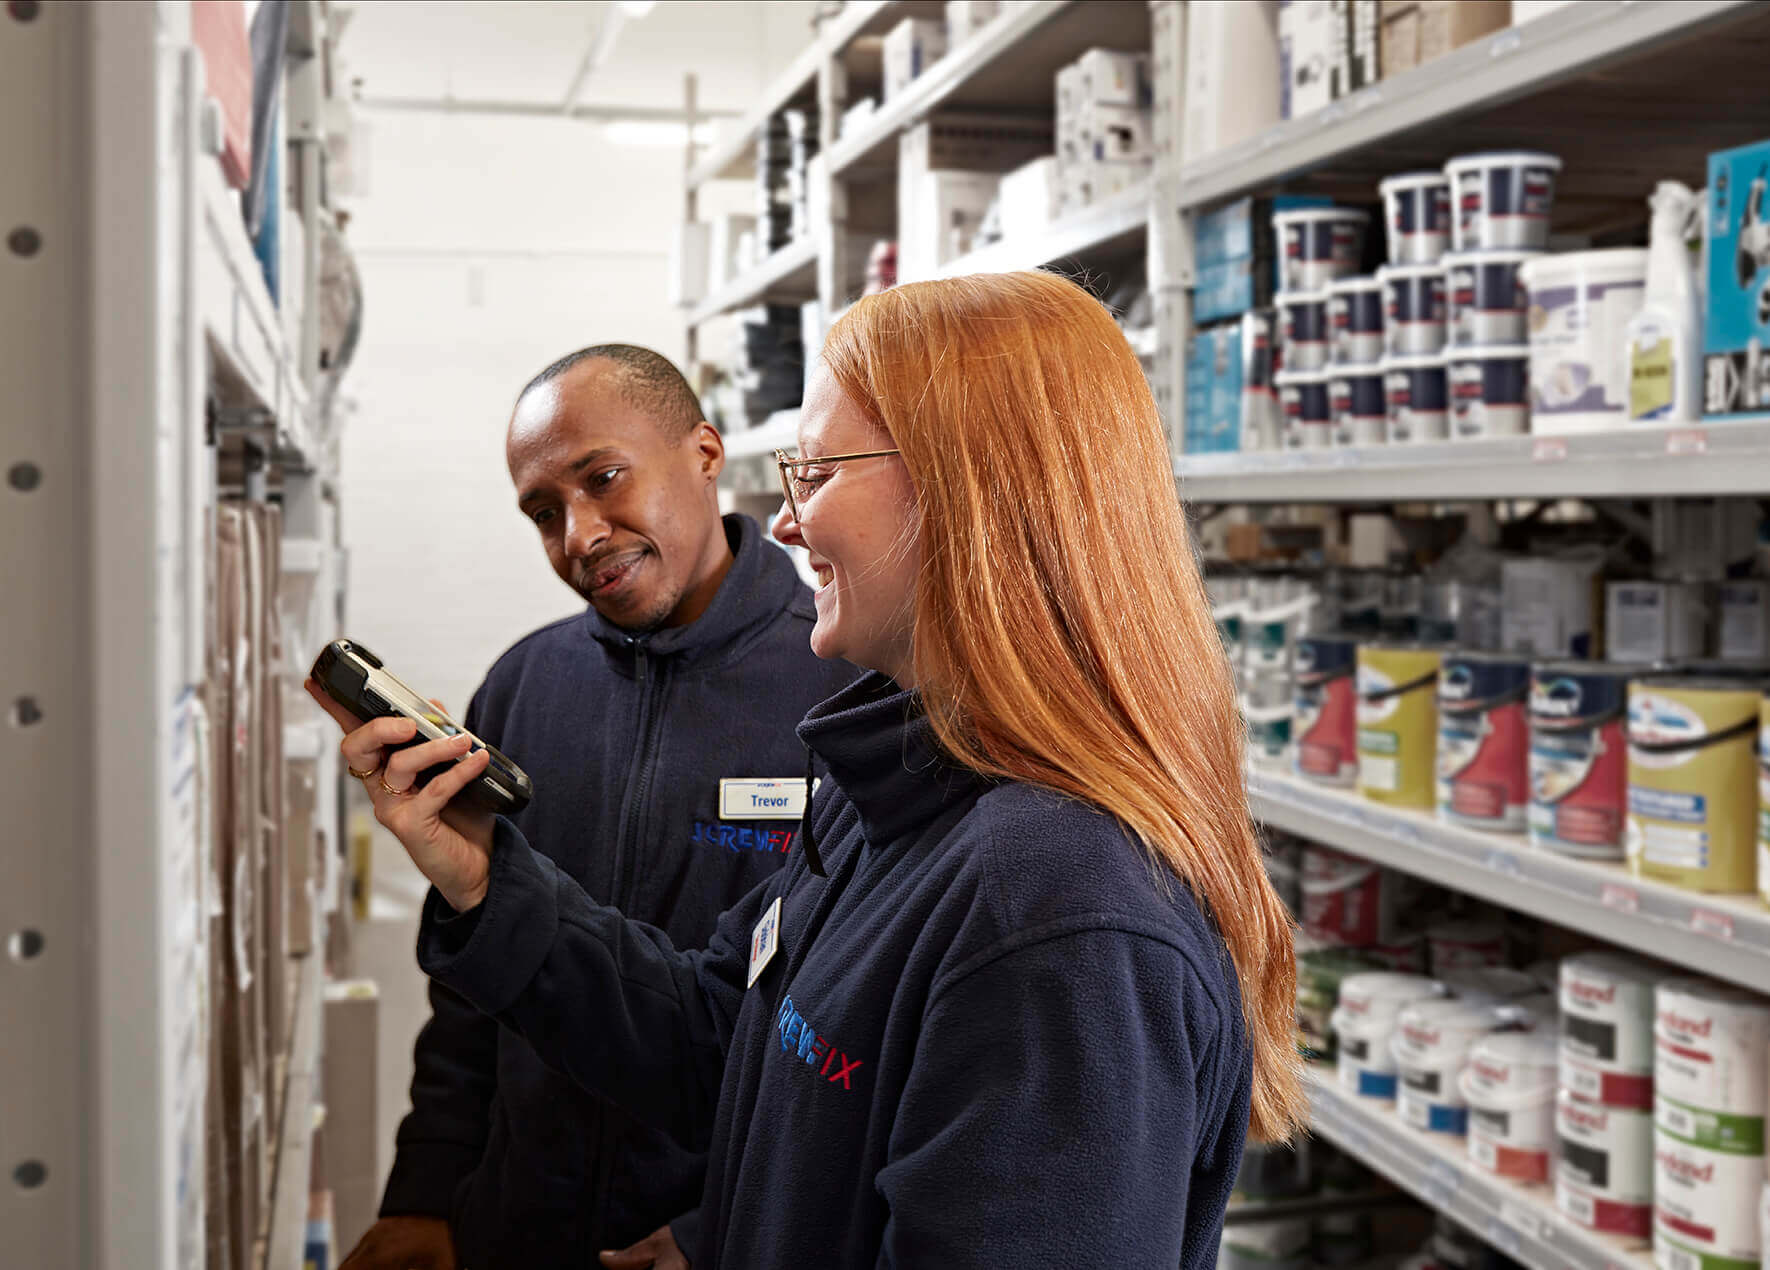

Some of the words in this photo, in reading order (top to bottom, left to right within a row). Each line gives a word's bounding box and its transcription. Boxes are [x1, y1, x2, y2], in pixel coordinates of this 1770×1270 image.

[751, 794, 789, 807] Trevor
[691, 821, 797, 853] SCREWFI
[777, 994, 864, 1090] REWFIX
